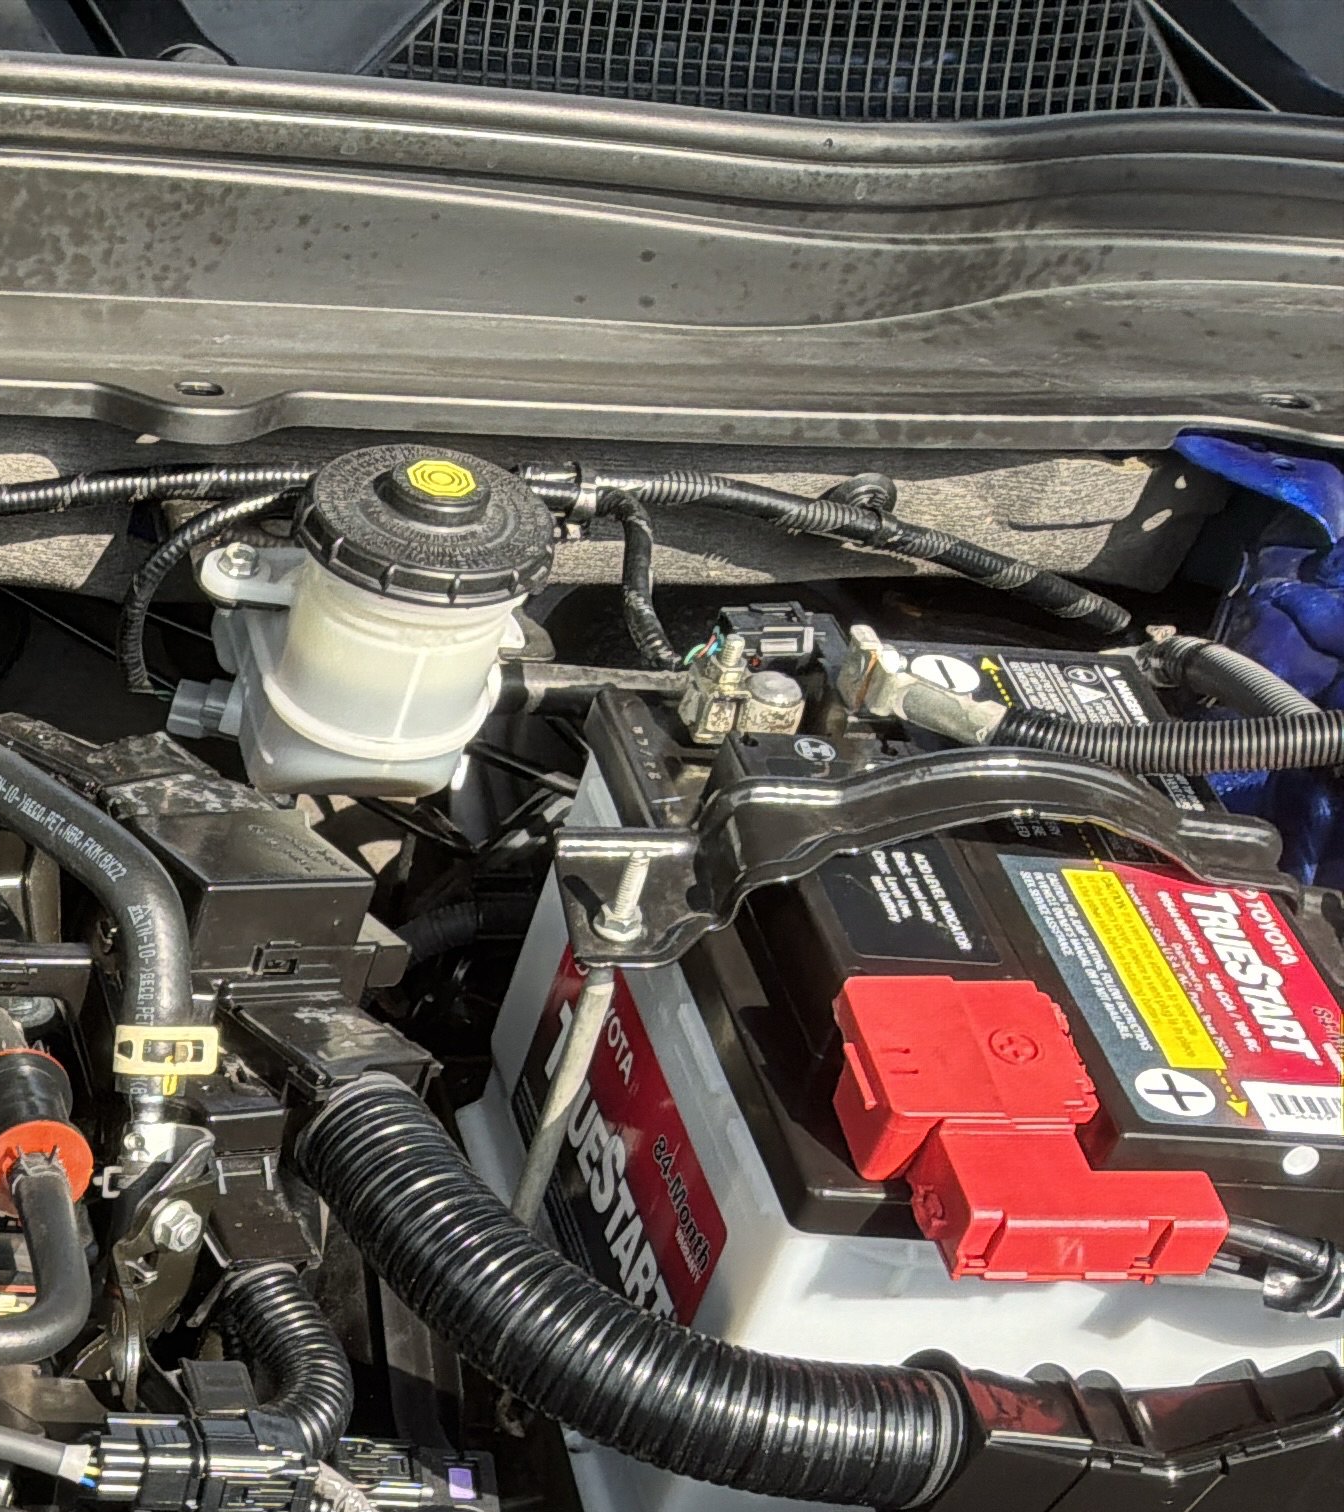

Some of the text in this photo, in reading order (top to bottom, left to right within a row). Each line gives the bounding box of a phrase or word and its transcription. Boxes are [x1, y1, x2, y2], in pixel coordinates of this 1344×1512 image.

[923, 875, 947, 900] LEVEL
[937, 900, 973, 951] INDICATOR
[1246, 901, 1299, 965] TOYOTA
[1182, 891, 1321, 1062] TRUESTART
[1214, 991, 1238, 1011] CCA
[652, 1134, 711, 1273] 84-Month
